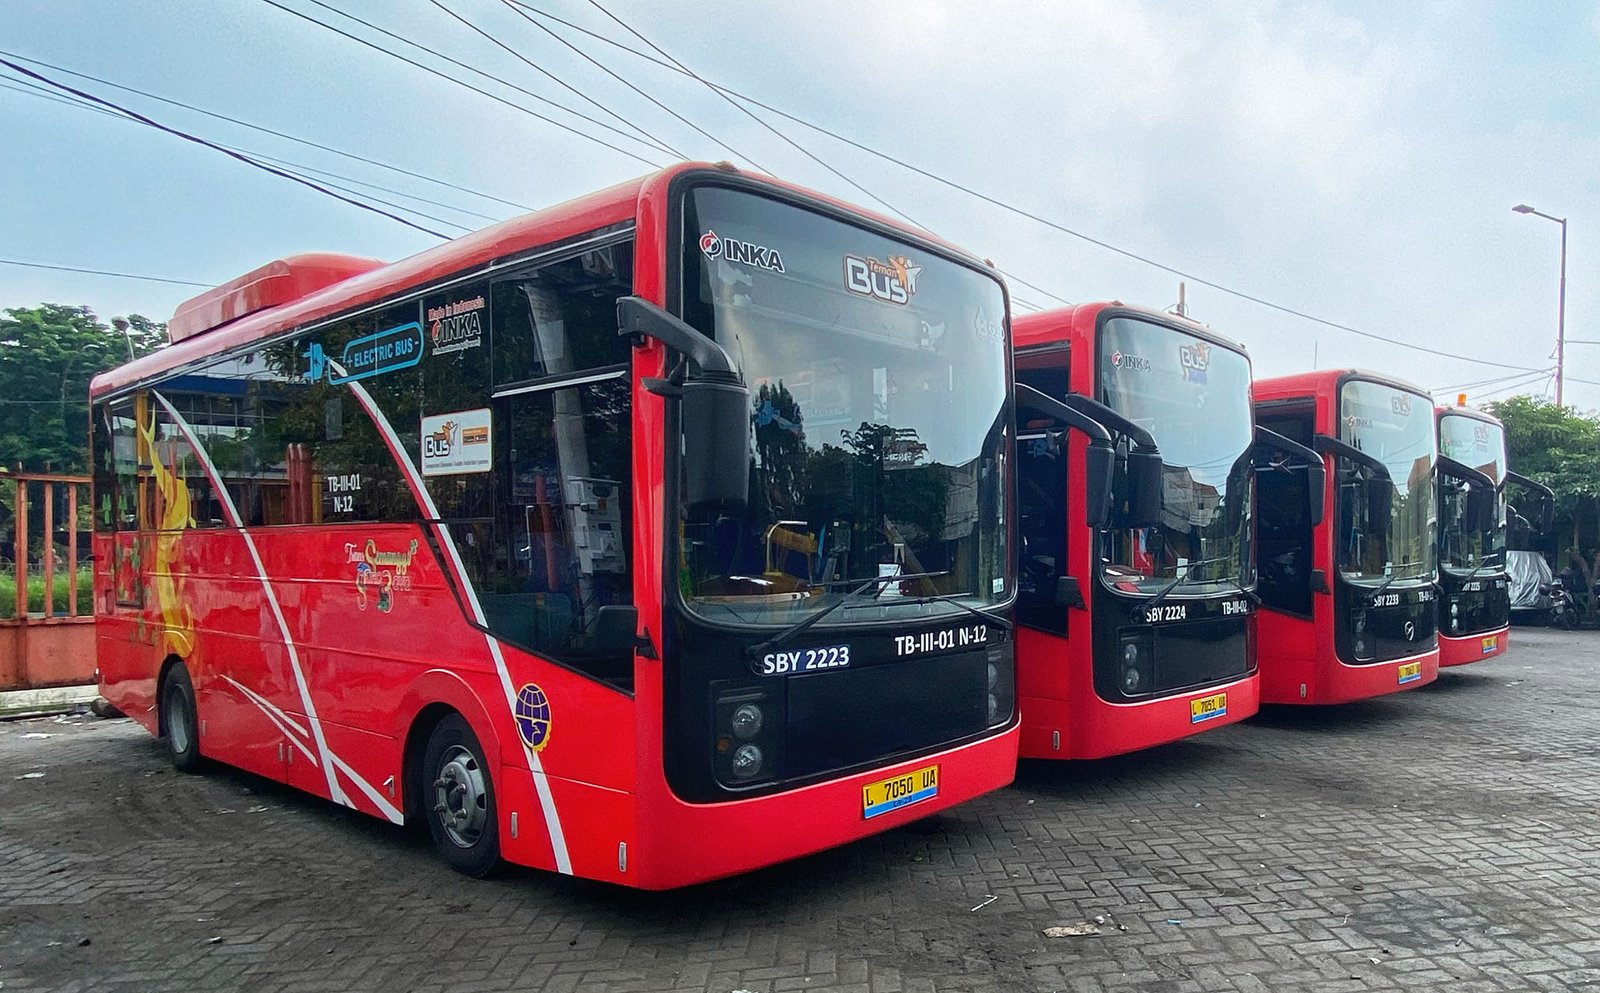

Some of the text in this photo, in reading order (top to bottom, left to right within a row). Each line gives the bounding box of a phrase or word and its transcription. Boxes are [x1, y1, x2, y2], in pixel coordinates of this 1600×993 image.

[724, 237, 785, 273] INKA
[868, 259, 898, 277] Teman
[428, 295, 485, 321] Made in Indonesia
[442, 312, 481, 342] INKA
[354, 345, 393, 368] ELECTRIC
[395, 337, 413, 357] BUS
[1124, 354, 1152, 373] INKA
[1356, 418, 1374, 429] INKA
[328, 474, 361, 493] TB-III-01
[334, 496, 353, 513] N-12
[1386, 594, 1399, 606] 2233
[1146, 605, 1186, 622] SBY 2224
[895, 624, 987, 656] TB-III-01 N-12
[763, 647, 849, 674] SBY 2223
[1192, 703, 1197, 715] L
[865, 788, 874, 807] L
[884, 776, 914, 801] 7050
[922, 769, 936, 788] UA
